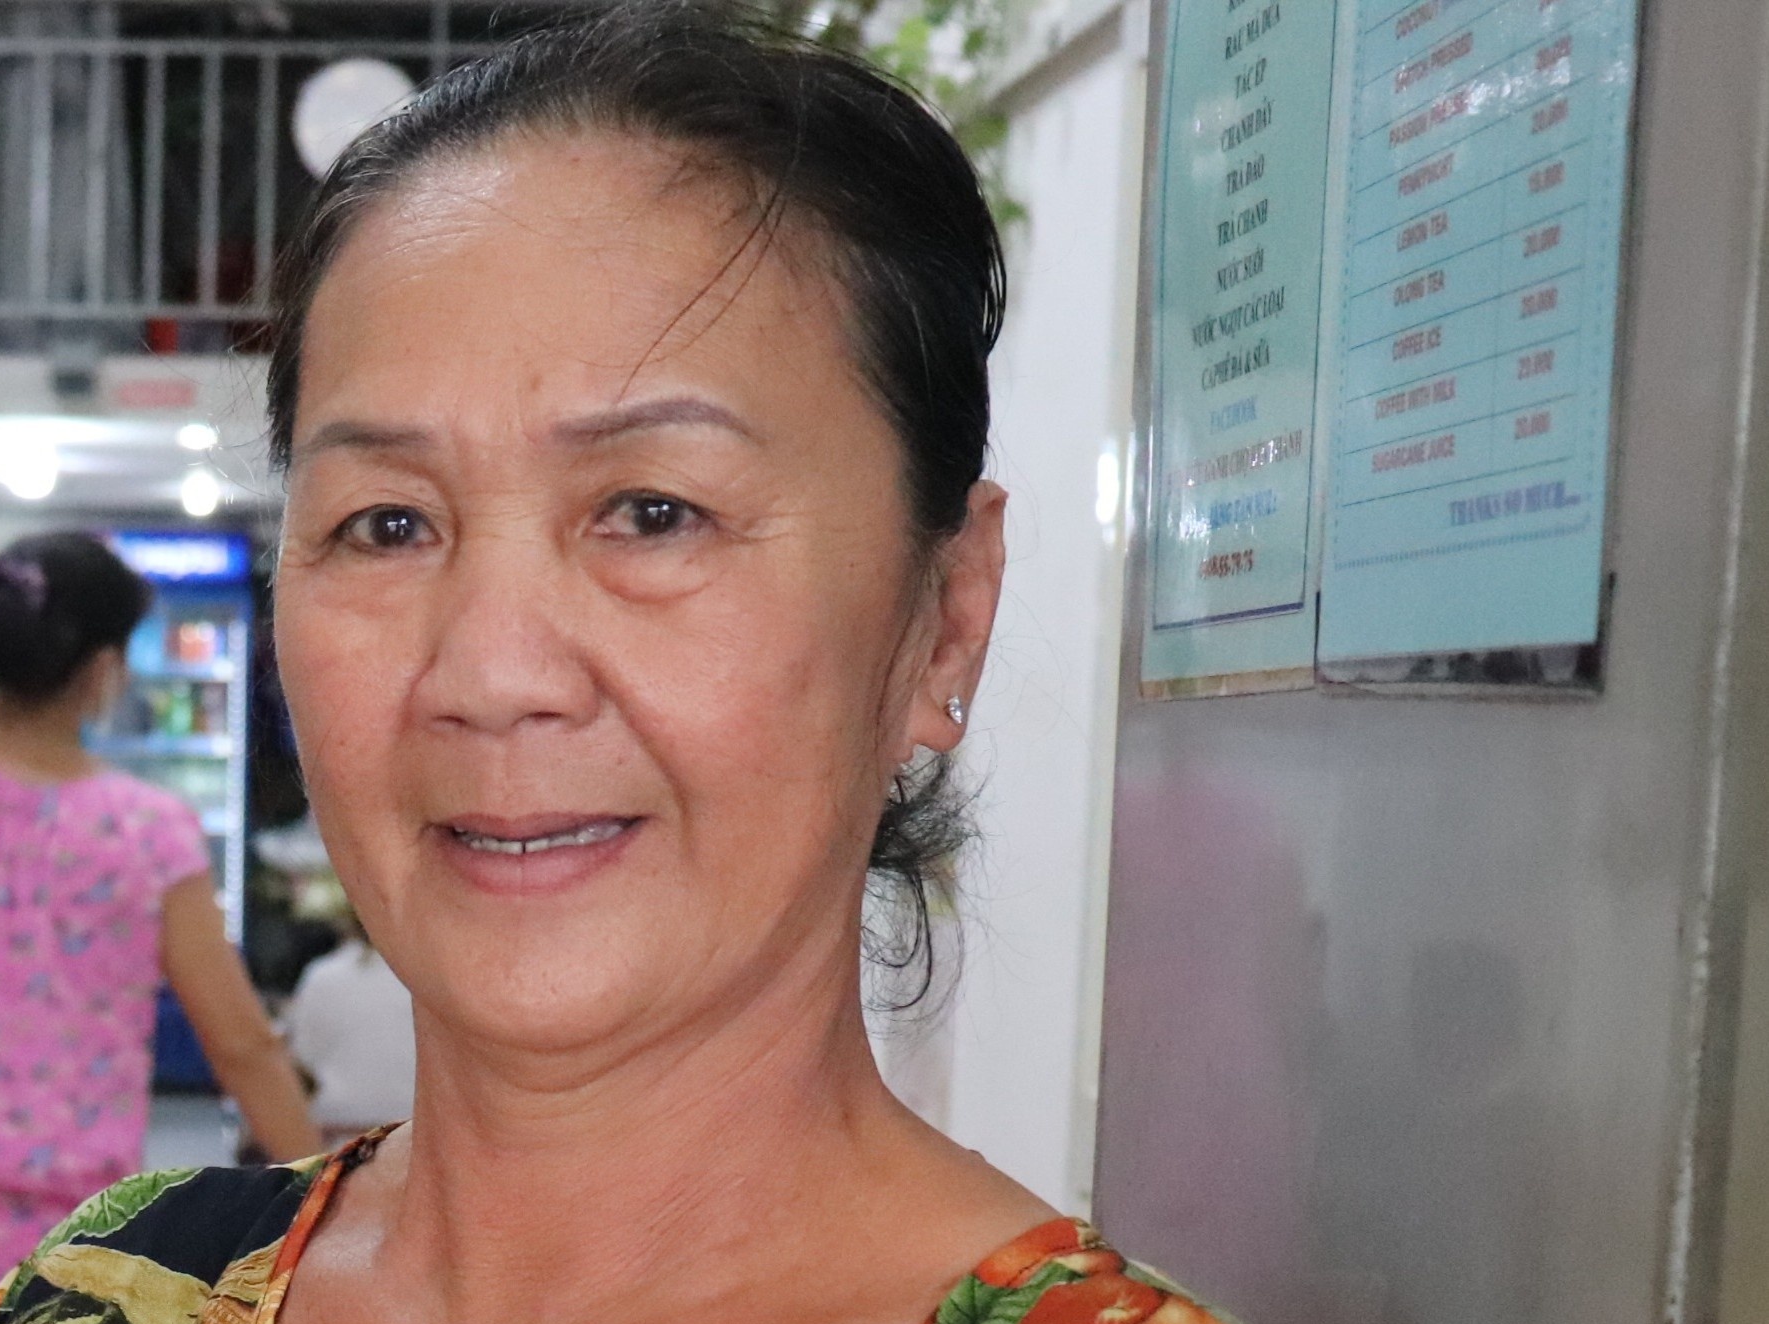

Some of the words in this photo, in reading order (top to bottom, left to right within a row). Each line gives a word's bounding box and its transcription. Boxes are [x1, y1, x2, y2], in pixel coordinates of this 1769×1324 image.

[1221, 112, 1254, 152] CHANH
[1237, 198, 1268, 237] CHANH
[1430, 211, 1449, 237] TEA
[1427, 269, 1446, 295] TEA
